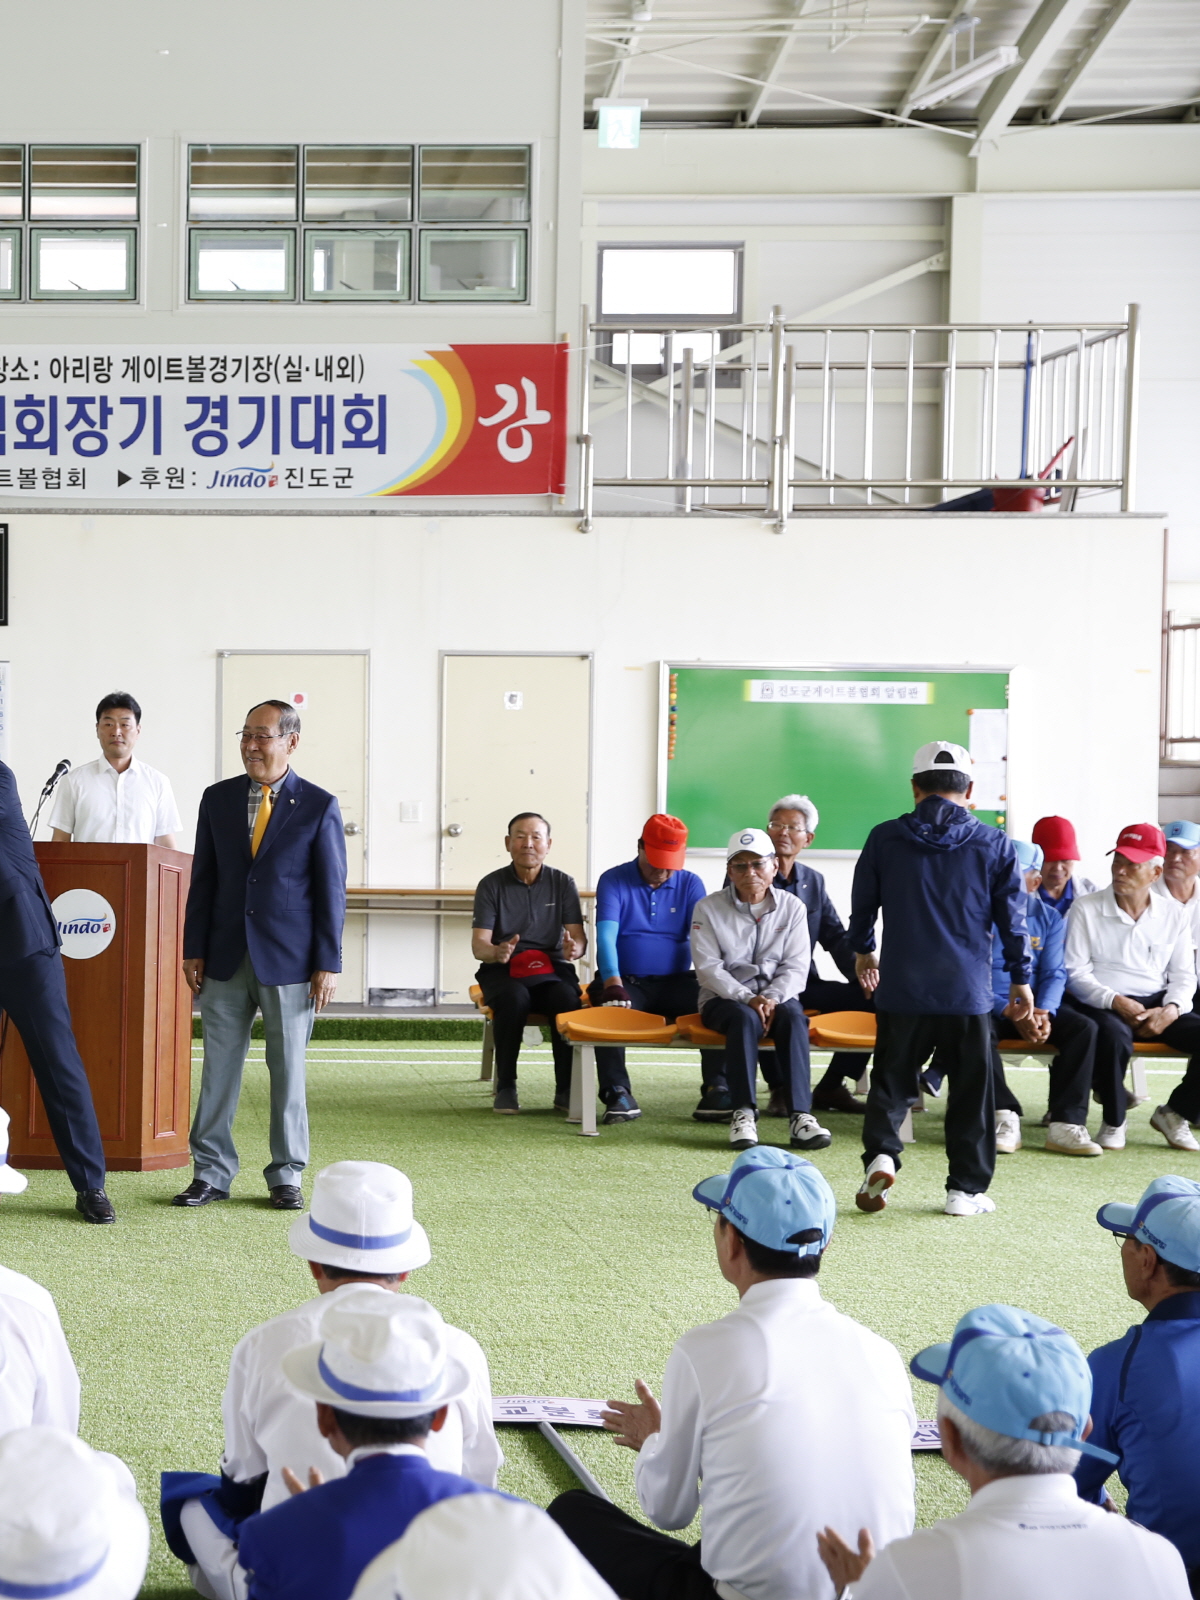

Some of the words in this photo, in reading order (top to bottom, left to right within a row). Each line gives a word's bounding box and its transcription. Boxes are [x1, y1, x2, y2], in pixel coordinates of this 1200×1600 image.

[49, 355, 113, 384] 아리랑
[121, 355, 365, 384] 게이트볼경기장(실·내외)
[184, 393, 387, 457] 경기대회
[478, 376, 551, 463] 강
[206, 467, 267, 490] Jindo
[284, 467, 354, 489] 진도군
